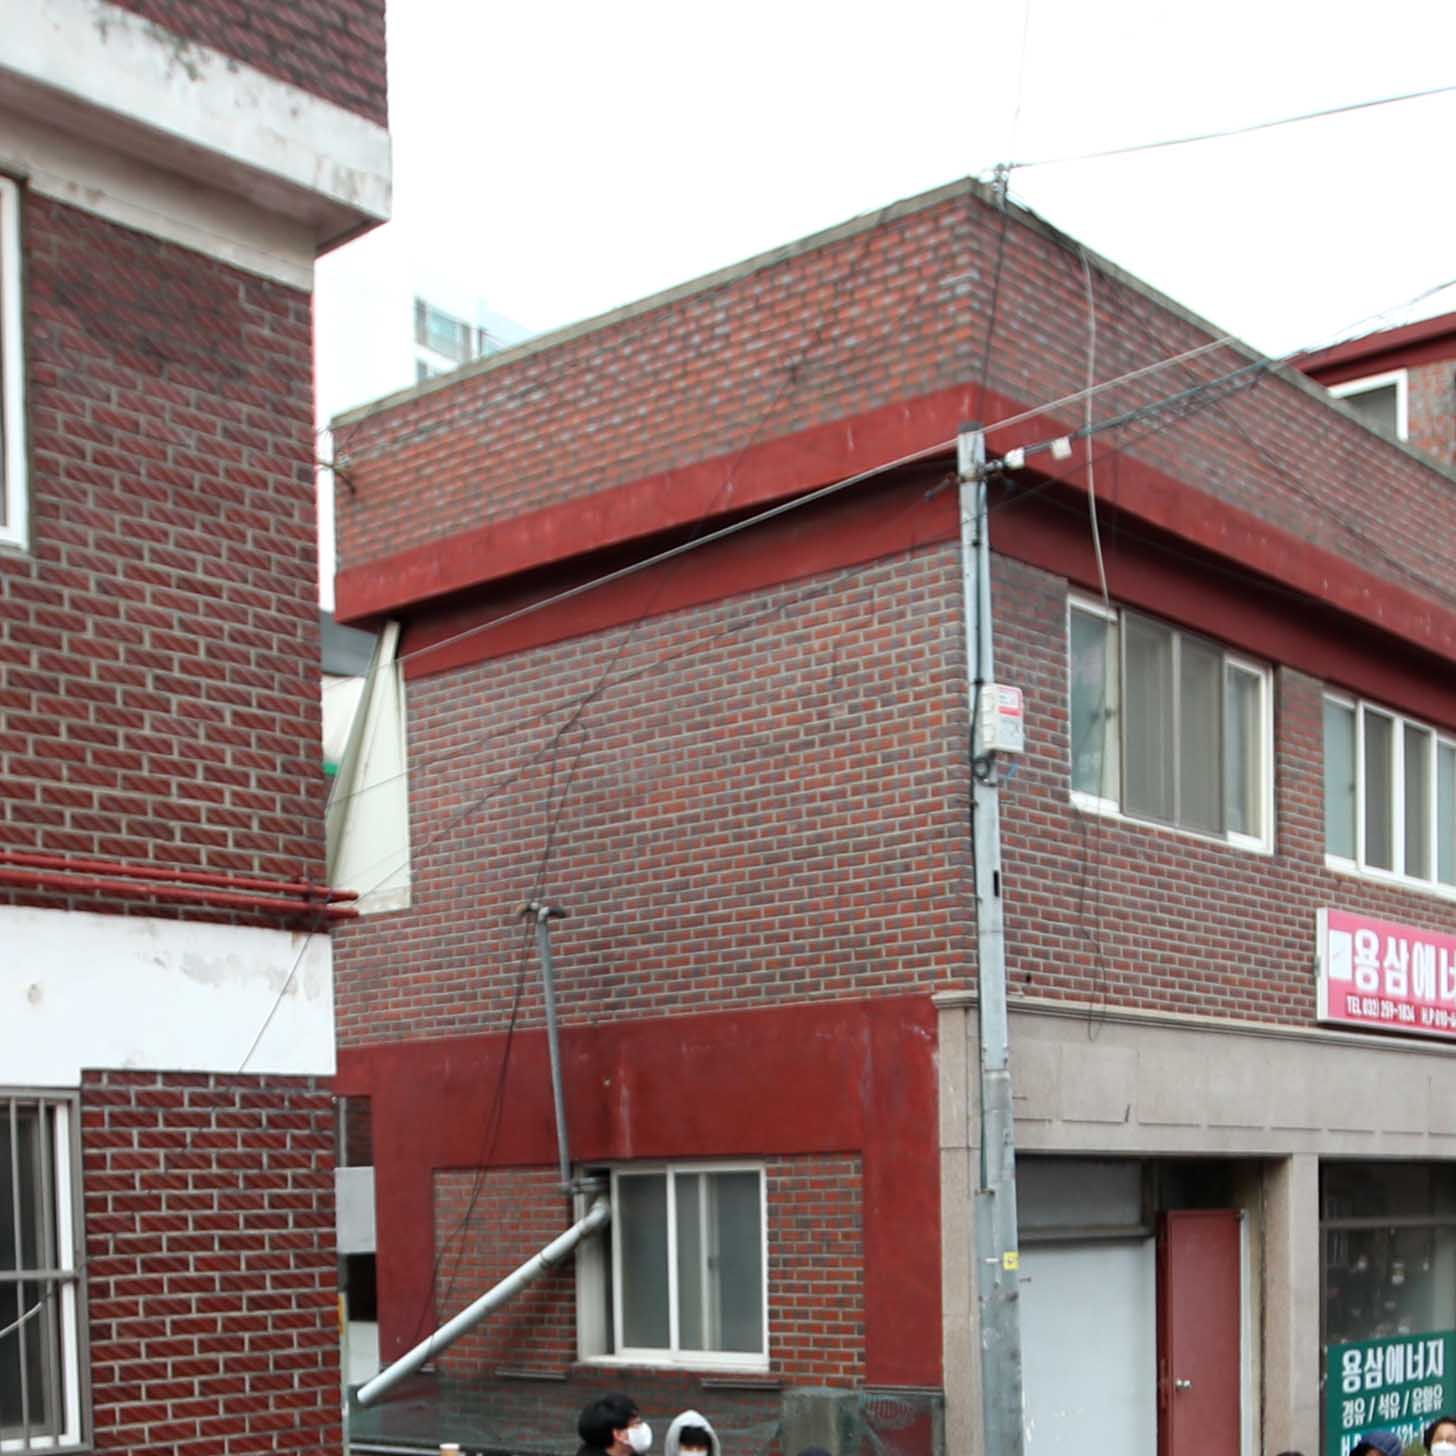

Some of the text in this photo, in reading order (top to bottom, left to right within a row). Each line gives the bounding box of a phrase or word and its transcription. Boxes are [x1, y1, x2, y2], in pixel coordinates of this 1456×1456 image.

[1342, 1339, 1444, 1394] 용삼에너지
[1342, 1397, 1365, 1429] 경유
[1378, 1391, 1401, 1420] 석유
